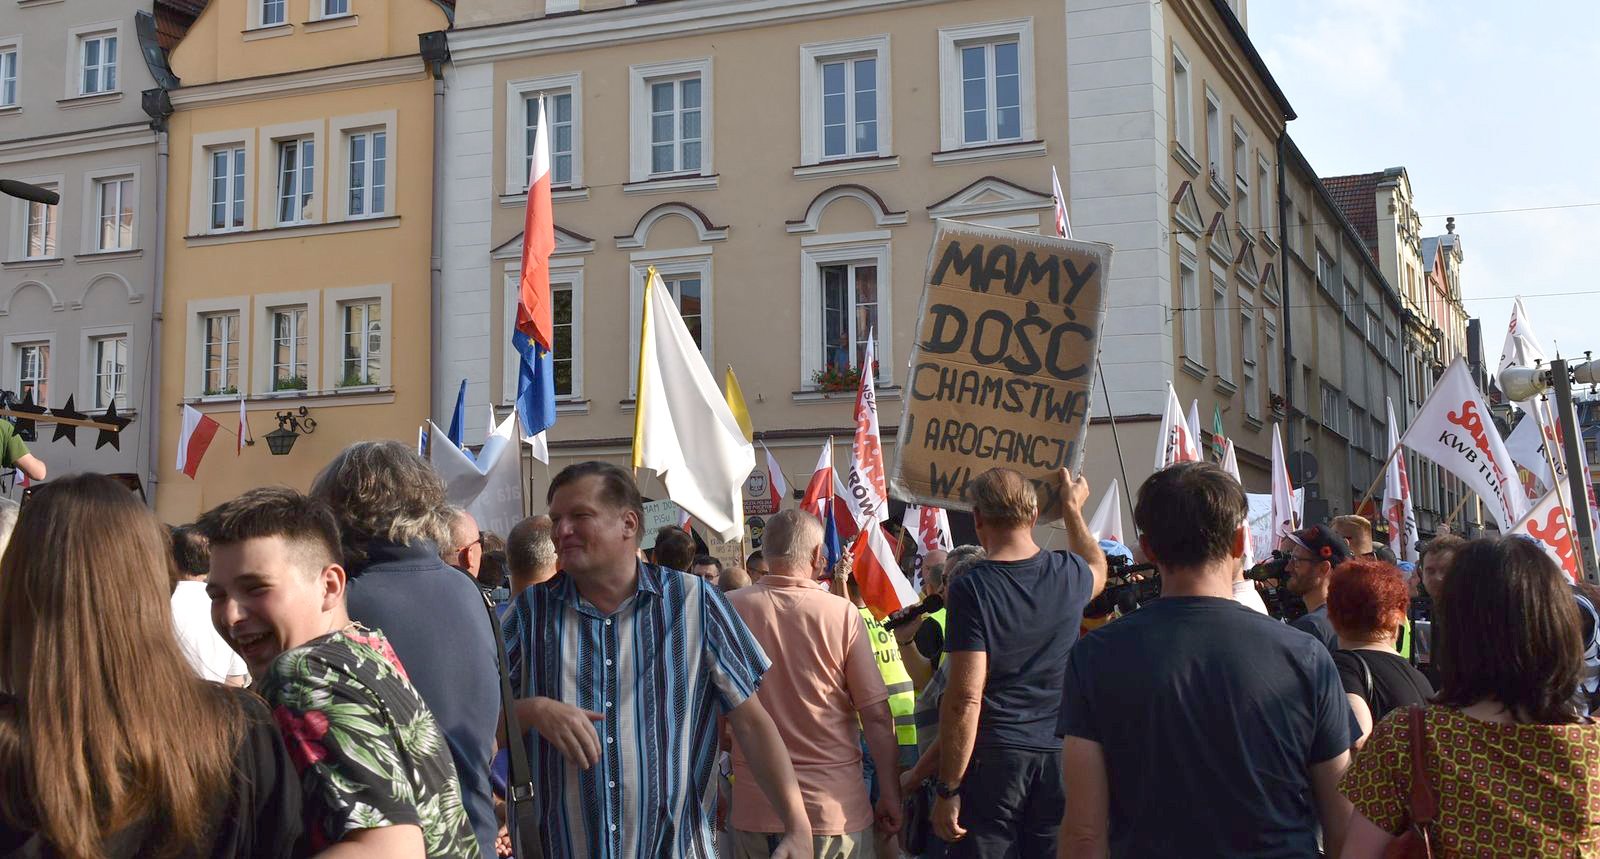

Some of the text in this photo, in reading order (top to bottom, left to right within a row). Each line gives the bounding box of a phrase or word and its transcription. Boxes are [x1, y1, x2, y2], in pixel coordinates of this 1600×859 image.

[931, 240, 1097, 305] MAMY
[922, 301, 1095, 381] DOŚĆ
[911, 363, 1091, 426] CHAMSTWA
[904, 414, 915, 446] I
[924, 418, 1076, 471] AROGANCJI
[1438, 430, 1478, 463] KWB
